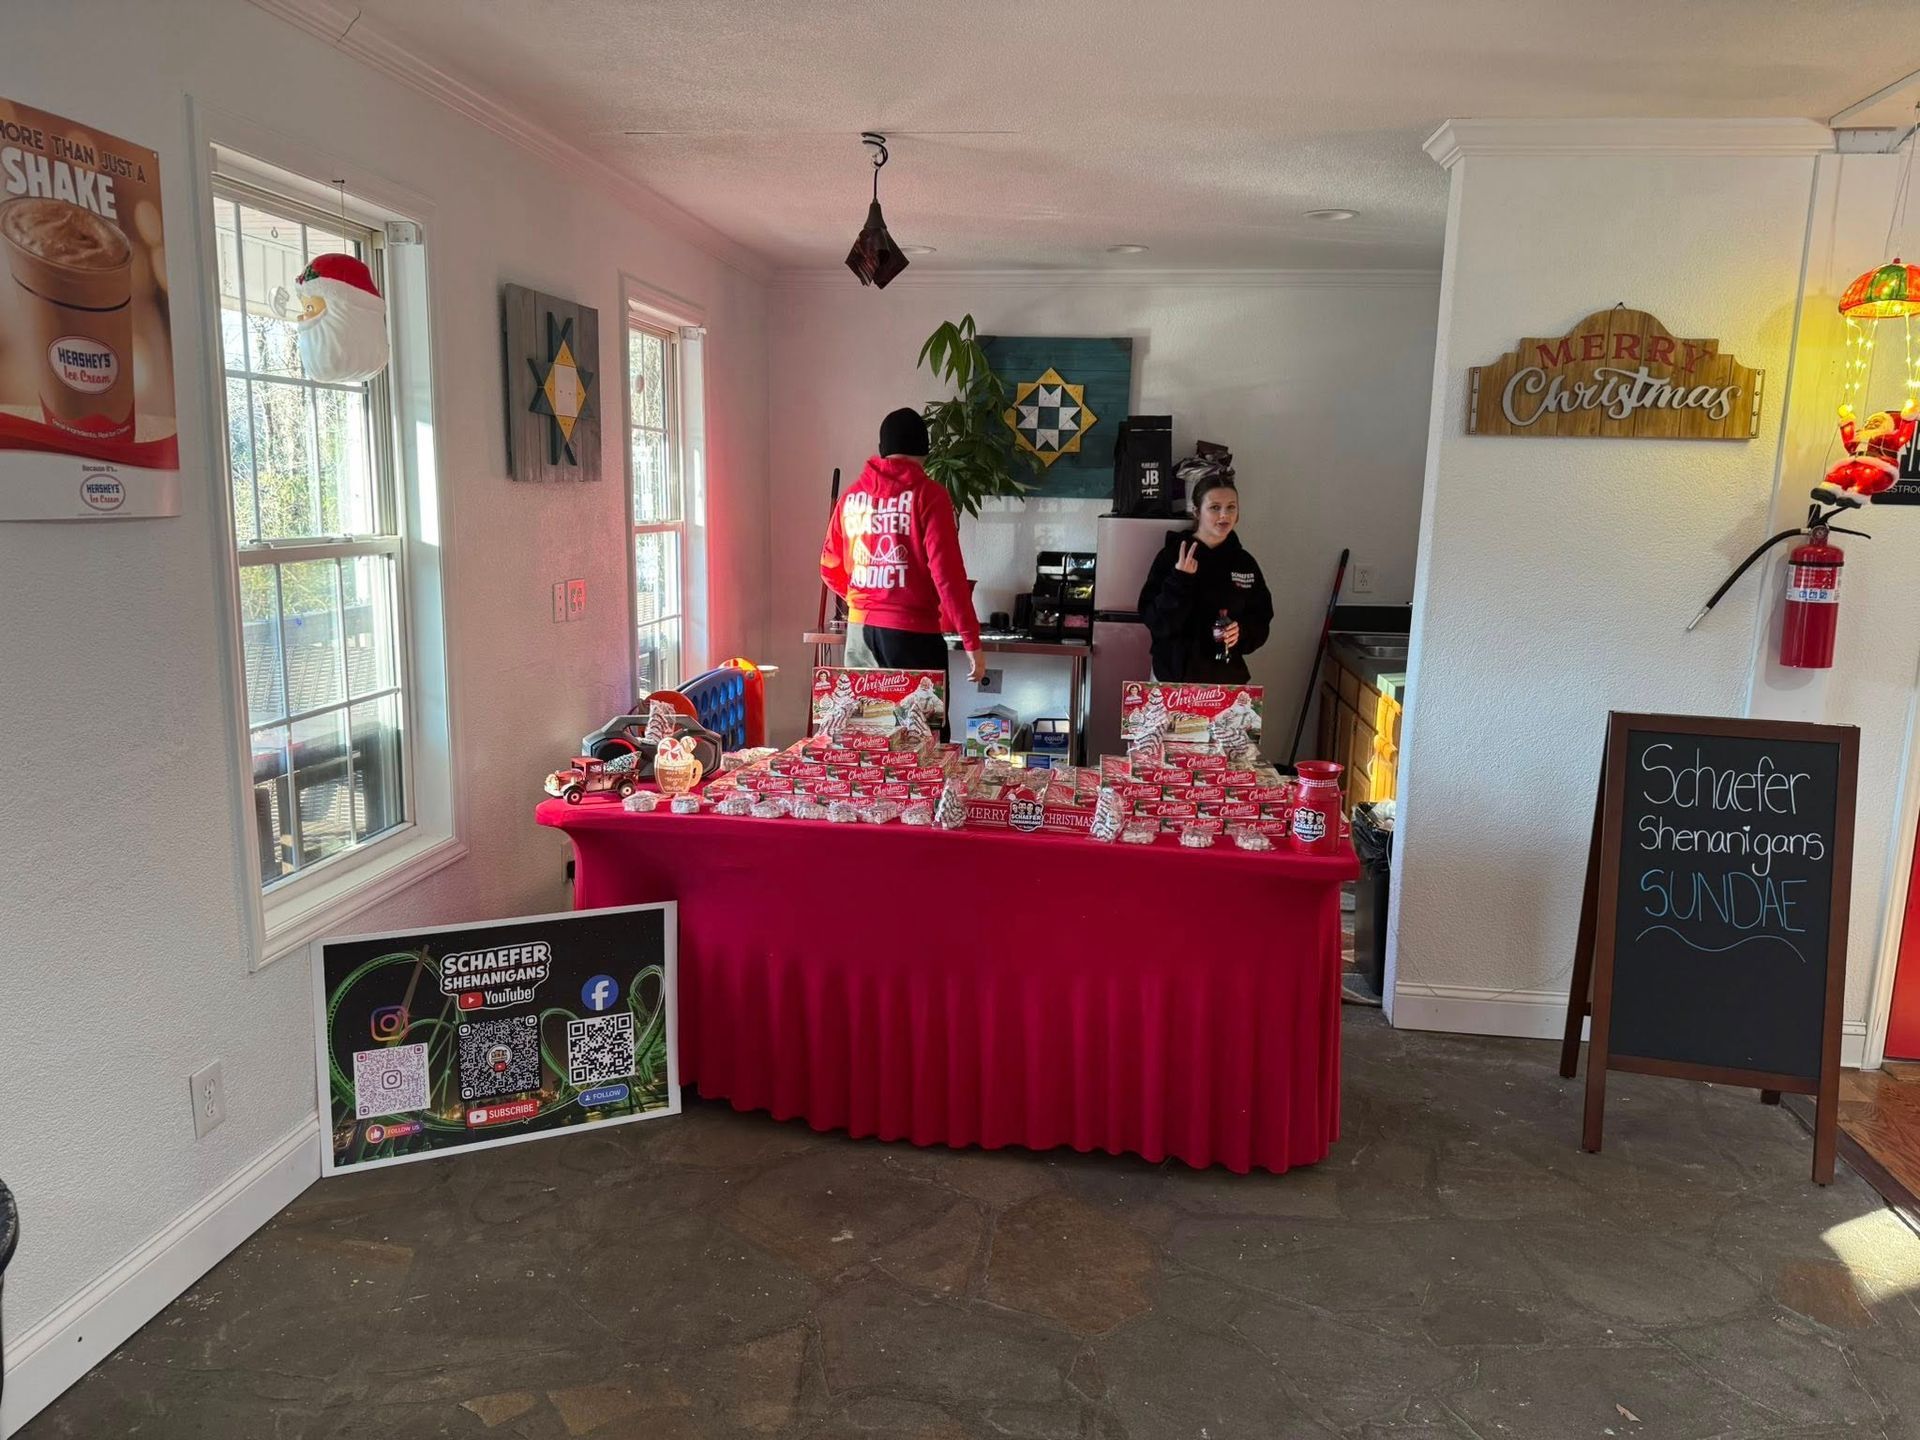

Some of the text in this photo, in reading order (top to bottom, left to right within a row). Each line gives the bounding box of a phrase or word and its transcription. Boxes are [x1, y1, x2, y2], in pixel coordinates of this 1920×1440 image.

[51, 135, 94, 166] THAN
[102, 153, 132, 177] JUST
[137, 165, 146, 183] A
[1, 146, 117, 220] SHAKE
[57, 346, 112, 369] HERSHEY'S
[1536, 333, 1713, 374] MERRY
[64, 366, 111, 385] Ice Cream
[1502, 366, 1742, 427] Christmas
[87, 483, 120, 494] HERSHEY'S
[1141, 469, 1159, 486] JB
[843, 490, 914, 514] ROLLER
[855, 670, 909, 694] Christmas
[1167, 685, 1226, 709] Christmas
[1641, 743, 1811, 815] Schaefer
[965, 807, 1007, 821] MERRY
[1638, 815, 1825, 877] Shenanigans
[1640, 869, 1807, 932] SUNDAE
[444, 945, 547, 975] SCHAEFER
[444, 965, 545, 991] SHENANIGANS
[485, 986, 532, 1005] YouTube
[592, 1089, 621, 1100] FOLLOW
[488, 1103, 534, 1119] SUBSCRIBE
[386, 1123, 420, 1135] FOLLOW US
